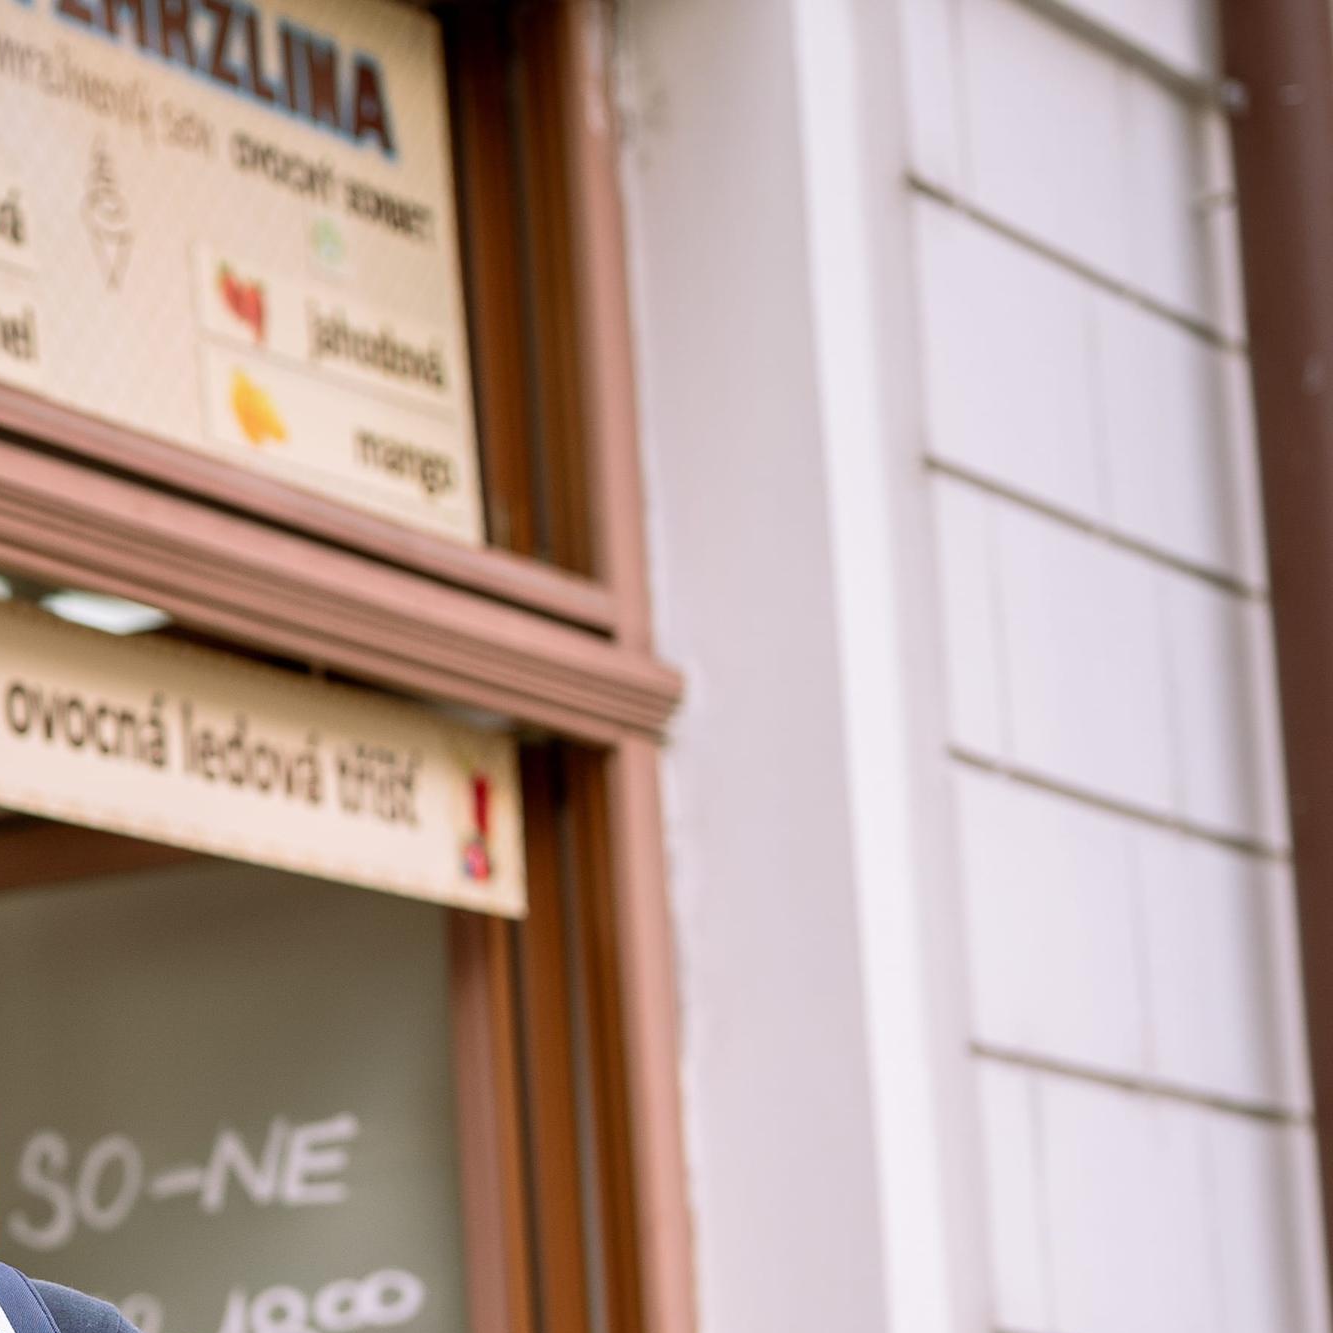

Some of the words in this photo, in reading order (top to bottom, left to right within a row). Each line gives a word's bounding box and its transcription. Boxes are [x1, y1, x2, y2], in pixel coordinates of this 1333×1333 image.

[47, 0, 399, 162] RZLINA
[5, 676, 168, 769] ovocná
[181, 700, 324, 807] ledová
[7, 1112, 359, 1252] SO-NE
